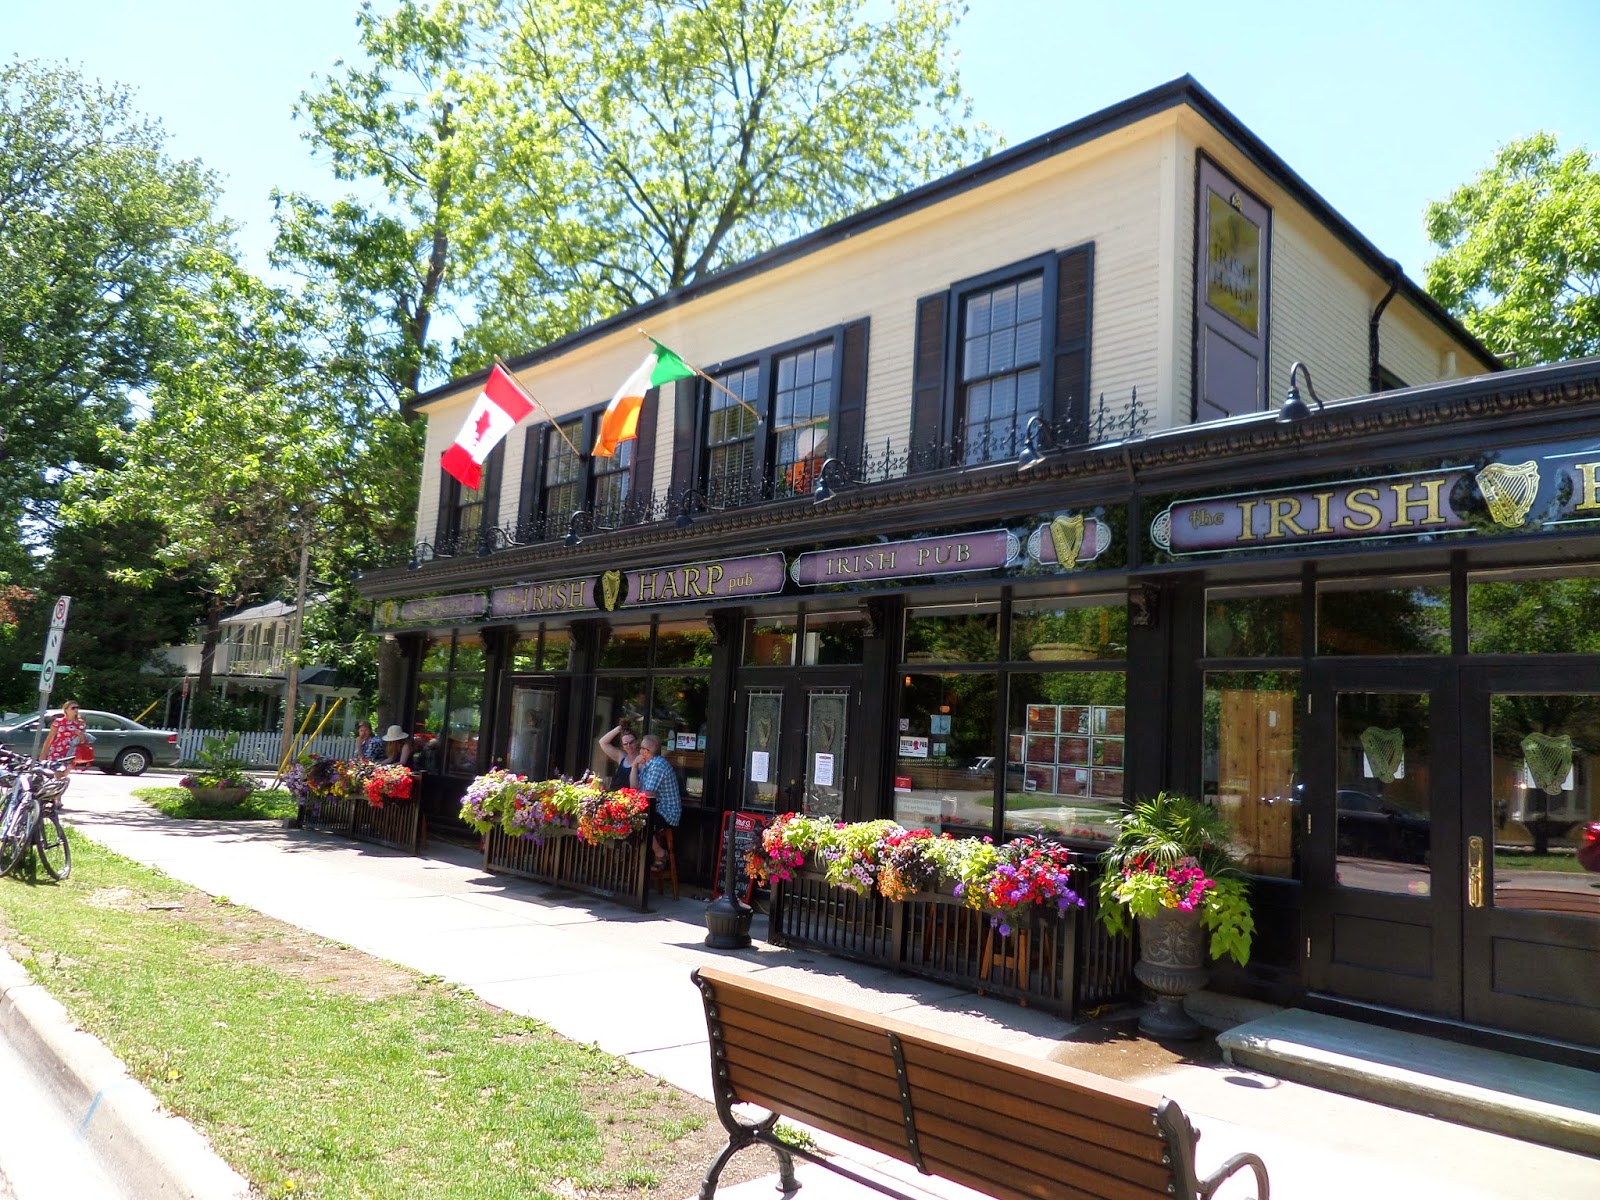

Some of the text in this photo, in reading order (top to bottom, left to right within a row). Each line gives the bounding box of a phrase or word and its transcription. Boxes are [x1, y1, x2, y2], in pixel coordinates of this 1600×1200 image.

[1188, 478, 1447, 543] the IRISH
[825, 543, 972, 576] IRISH PUB
[520, 580, 587, 613] IRISH
[636, 564, 725, 602] HARP
[728, 572, 754, 592] pub
